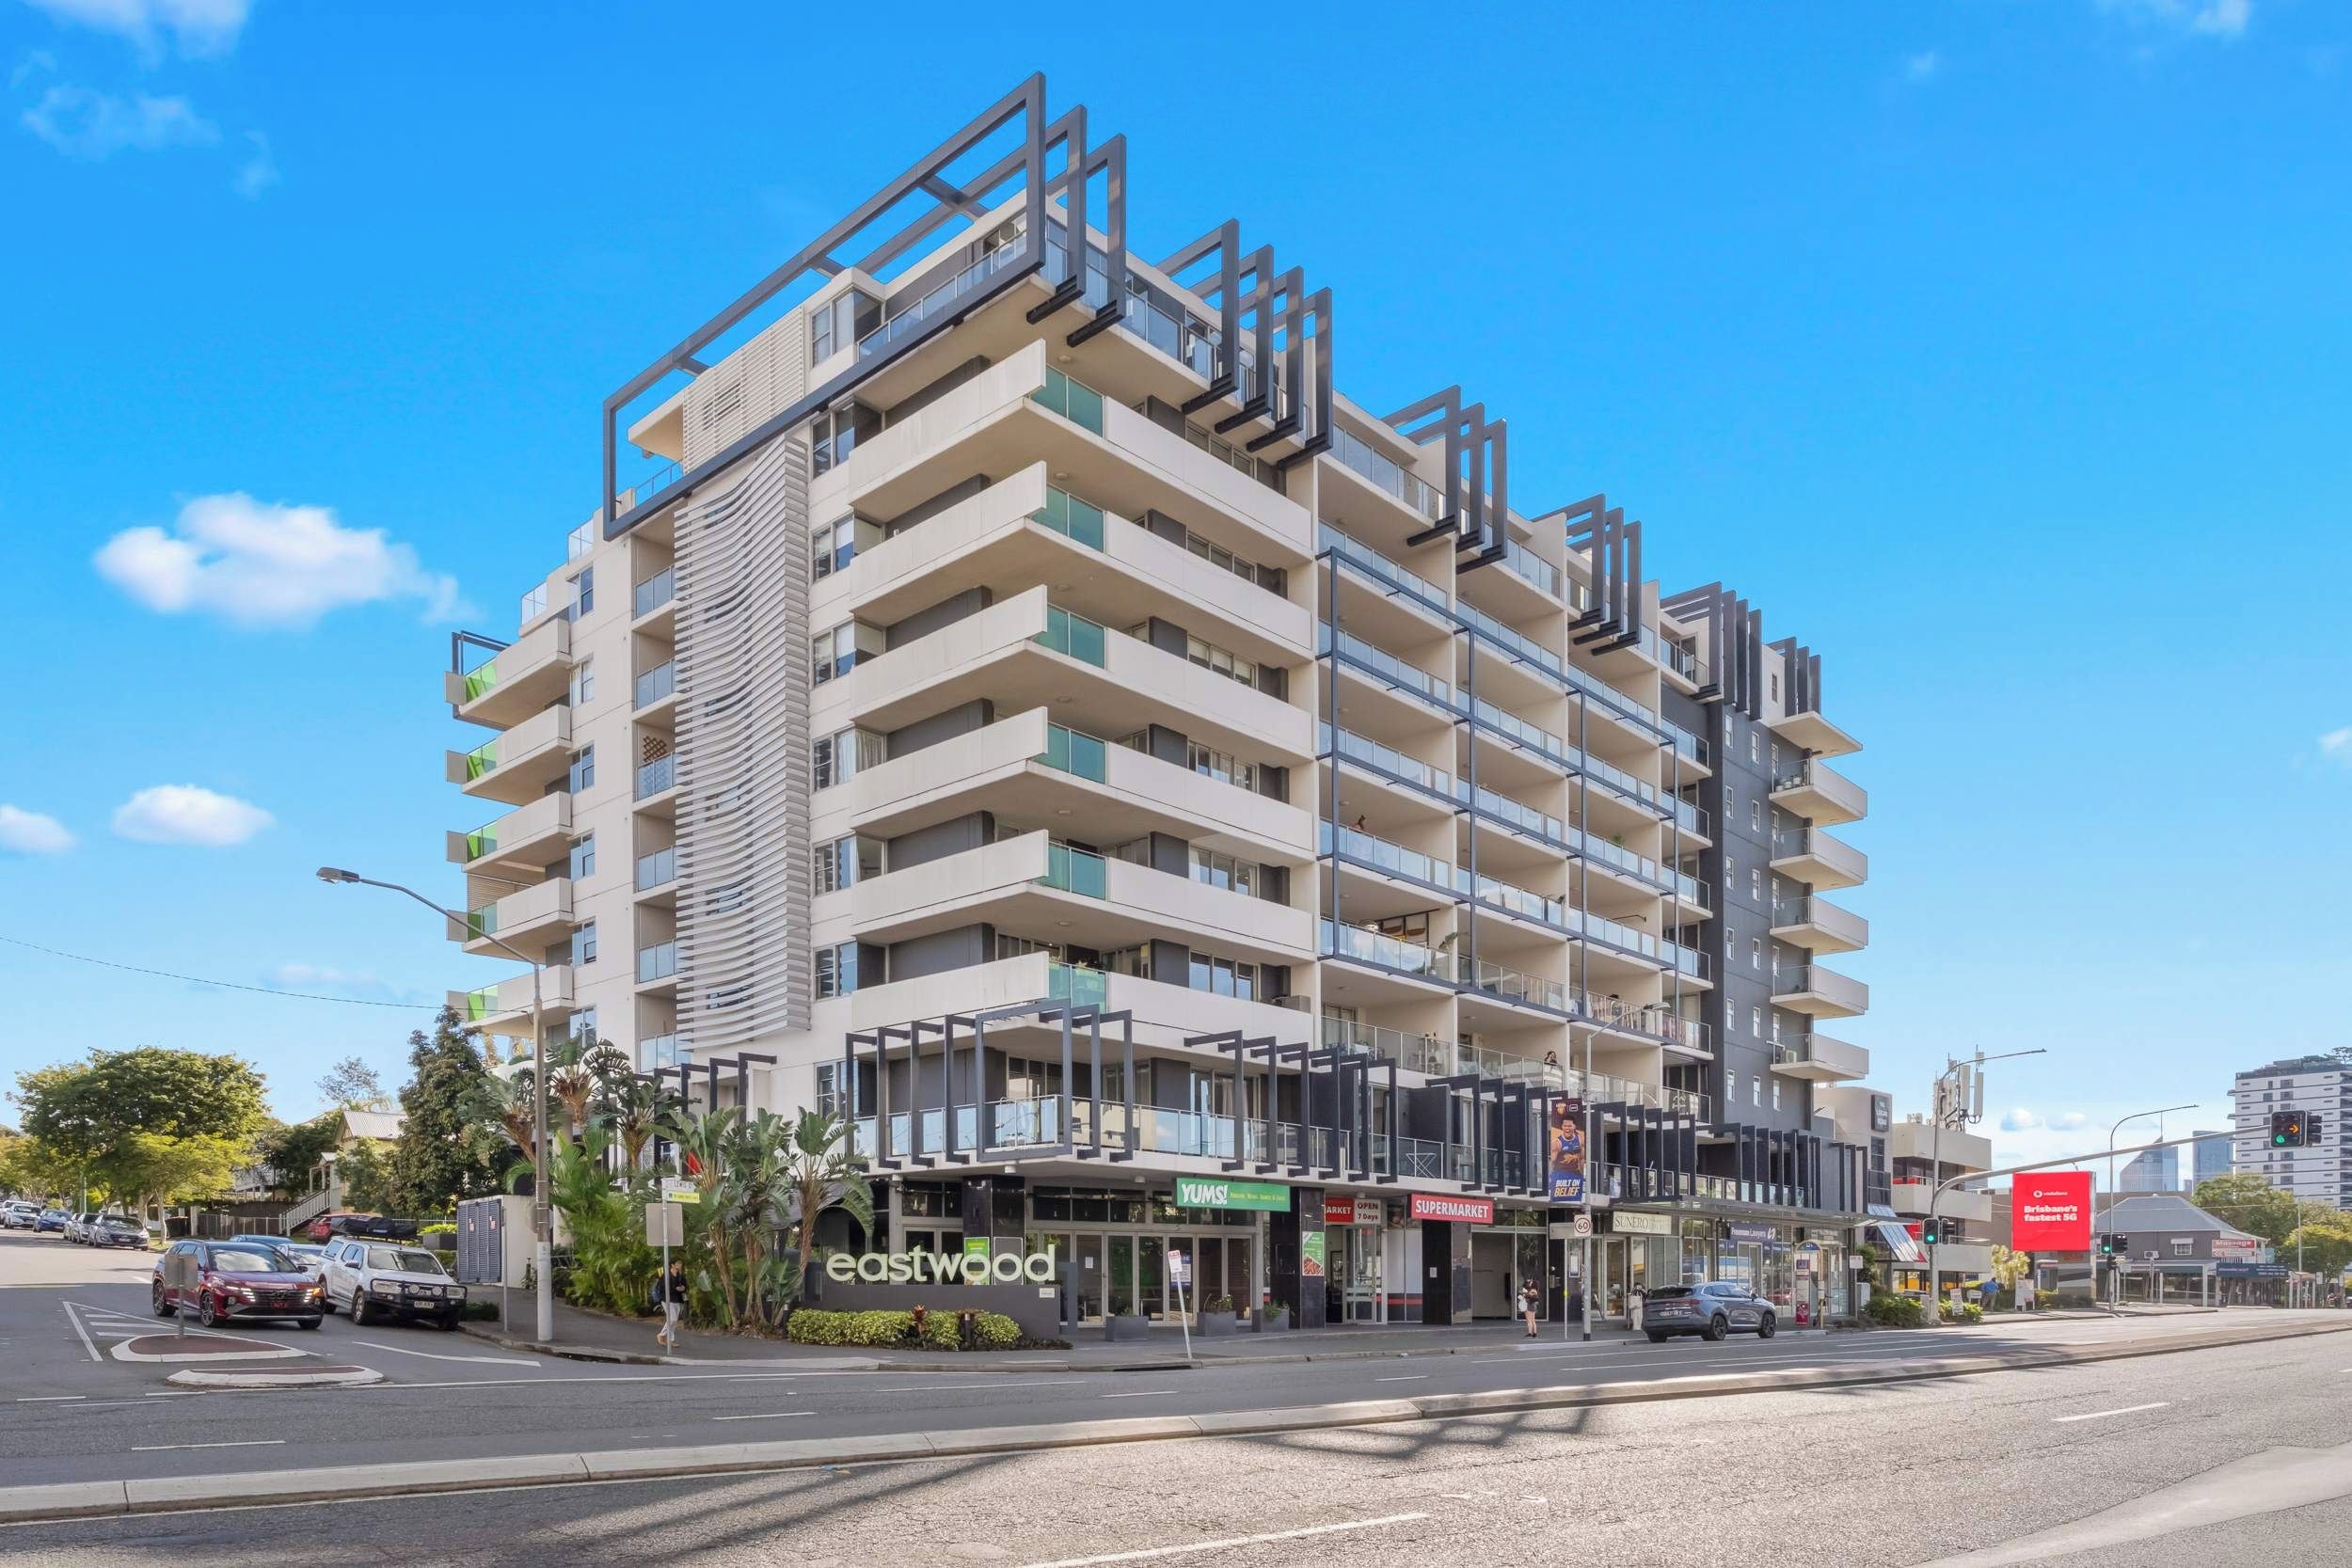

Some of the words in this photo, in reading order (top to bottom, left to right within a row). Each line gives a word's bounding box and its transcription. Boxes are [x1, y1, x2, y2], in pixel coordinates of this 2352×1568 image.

[1556, 1179, 1572, 1187] BUILT
[1572, 1179, 1581, 1187] ON
[1182, 1183, 1229, 1205] YUMS!
[1554, 1187, 1581, 1197] BELIEF
[1325, 1206, 1352, 1215] ARKET
[1357, 1202, 1378, 1211] OPEN
[1415, 1199, 1489, 1219] SUPERMARKET
[2024, 1205, 2077, 1213] Brisbane's
[1362, 1213, 1378, 1222] Days
[2024, 1213, 2062, 1222] fastest
[1578, 1222, 1589, 1230] 60
[826, 1243, 1056, 1282] eastwood
